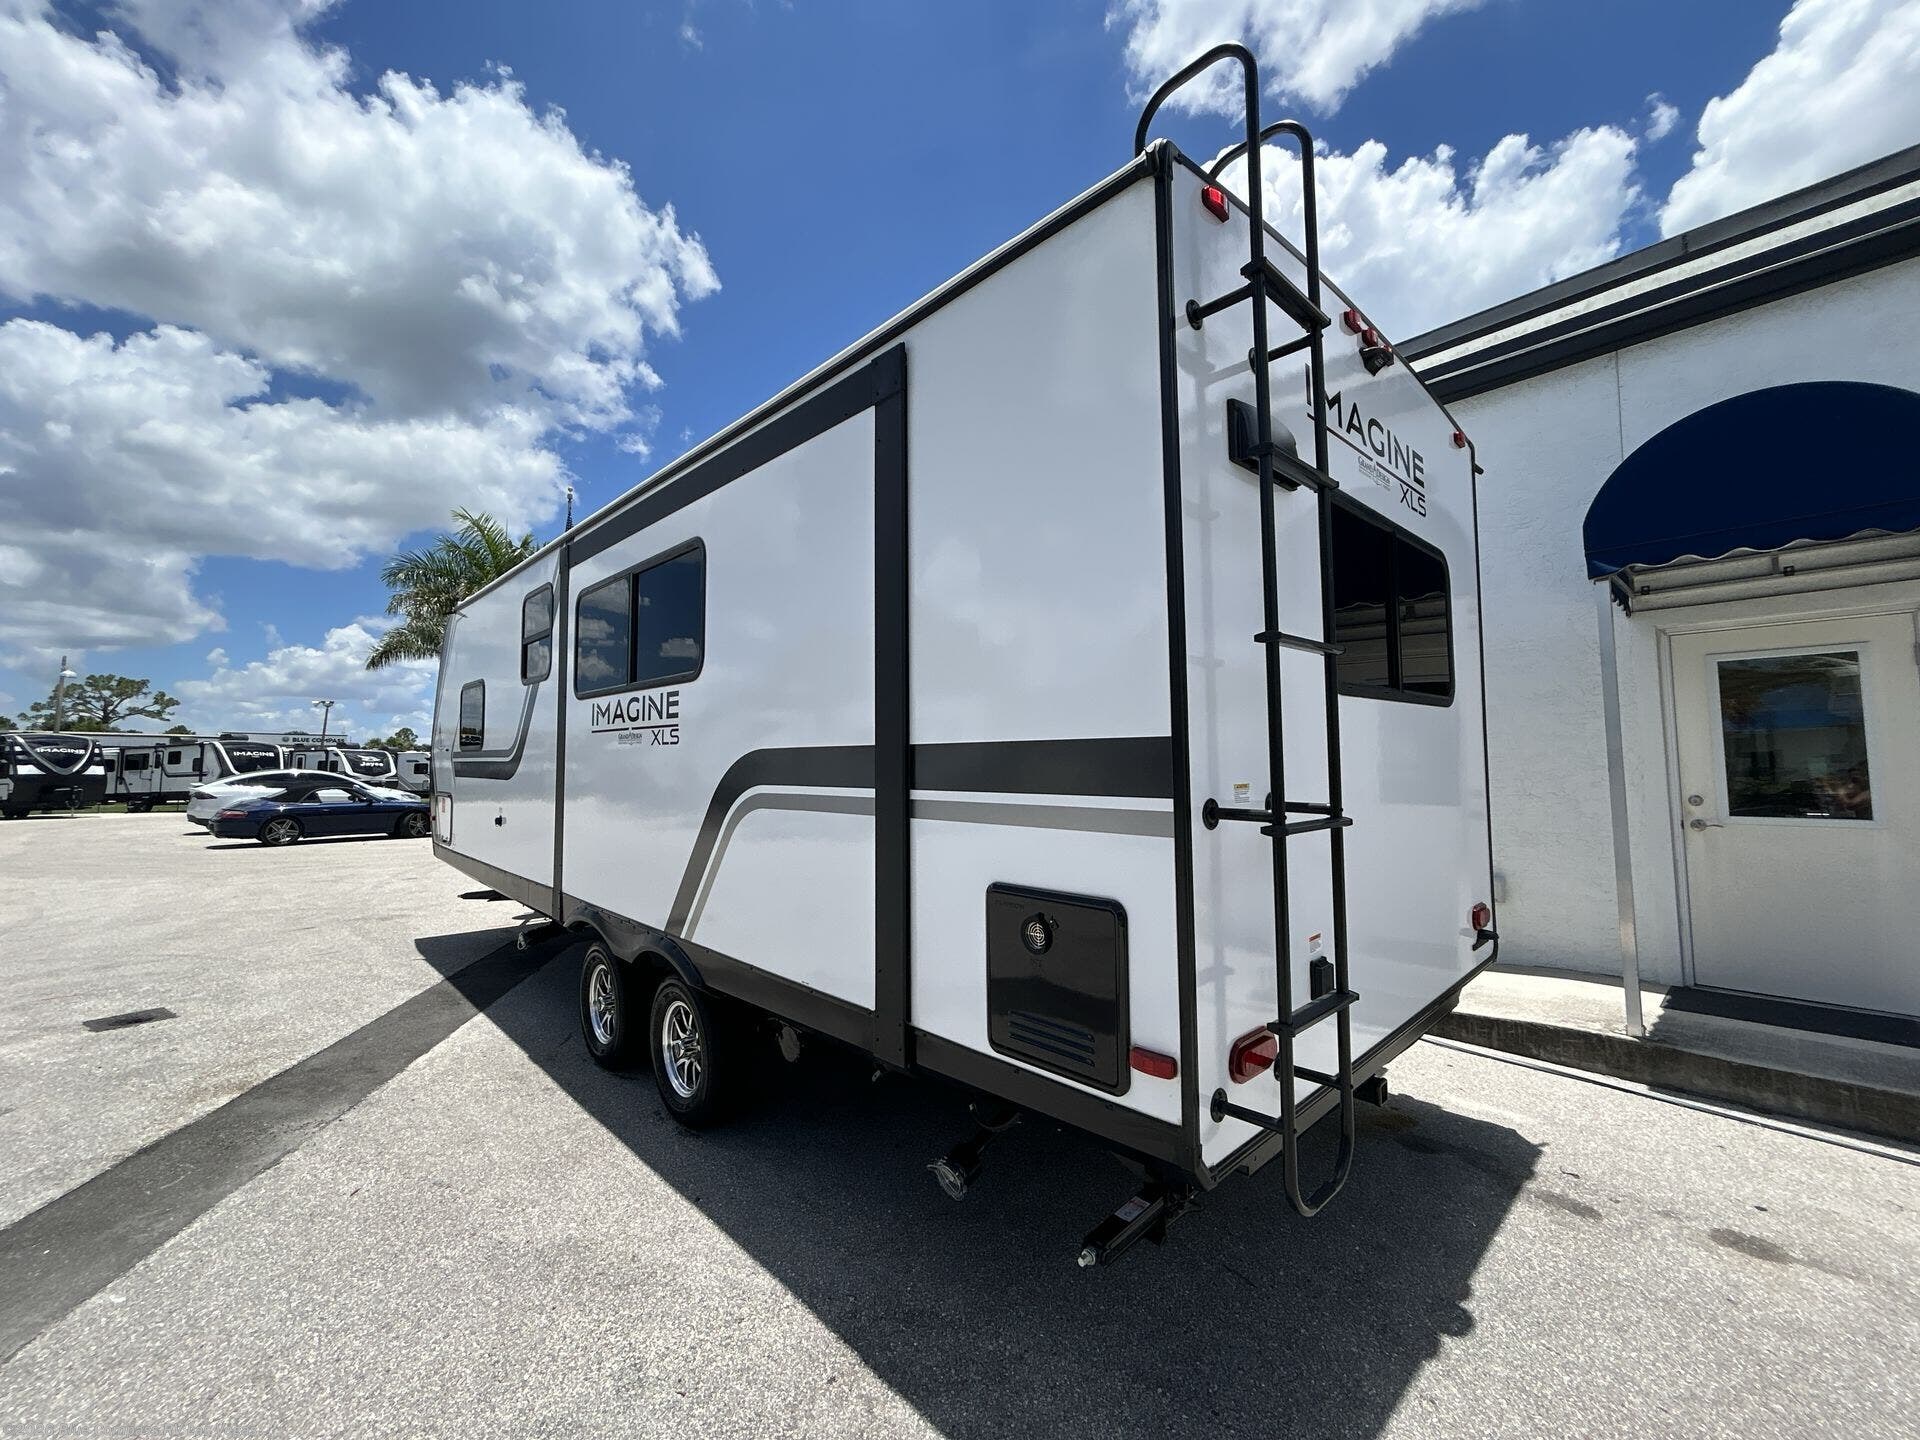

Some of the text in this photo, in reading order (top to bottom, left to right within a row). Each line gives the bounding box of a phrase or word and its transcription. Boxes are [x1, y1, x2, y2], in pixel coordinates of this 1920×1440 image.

[1304, 362, 1425, 489] IMAGINE
[1400, 483, 1427, 518] XLS
[591, 690, 680, 727] IMAGINE
[35, 747, 87, 755] IMAGINE
[651, 728, 680, 746] XLS
